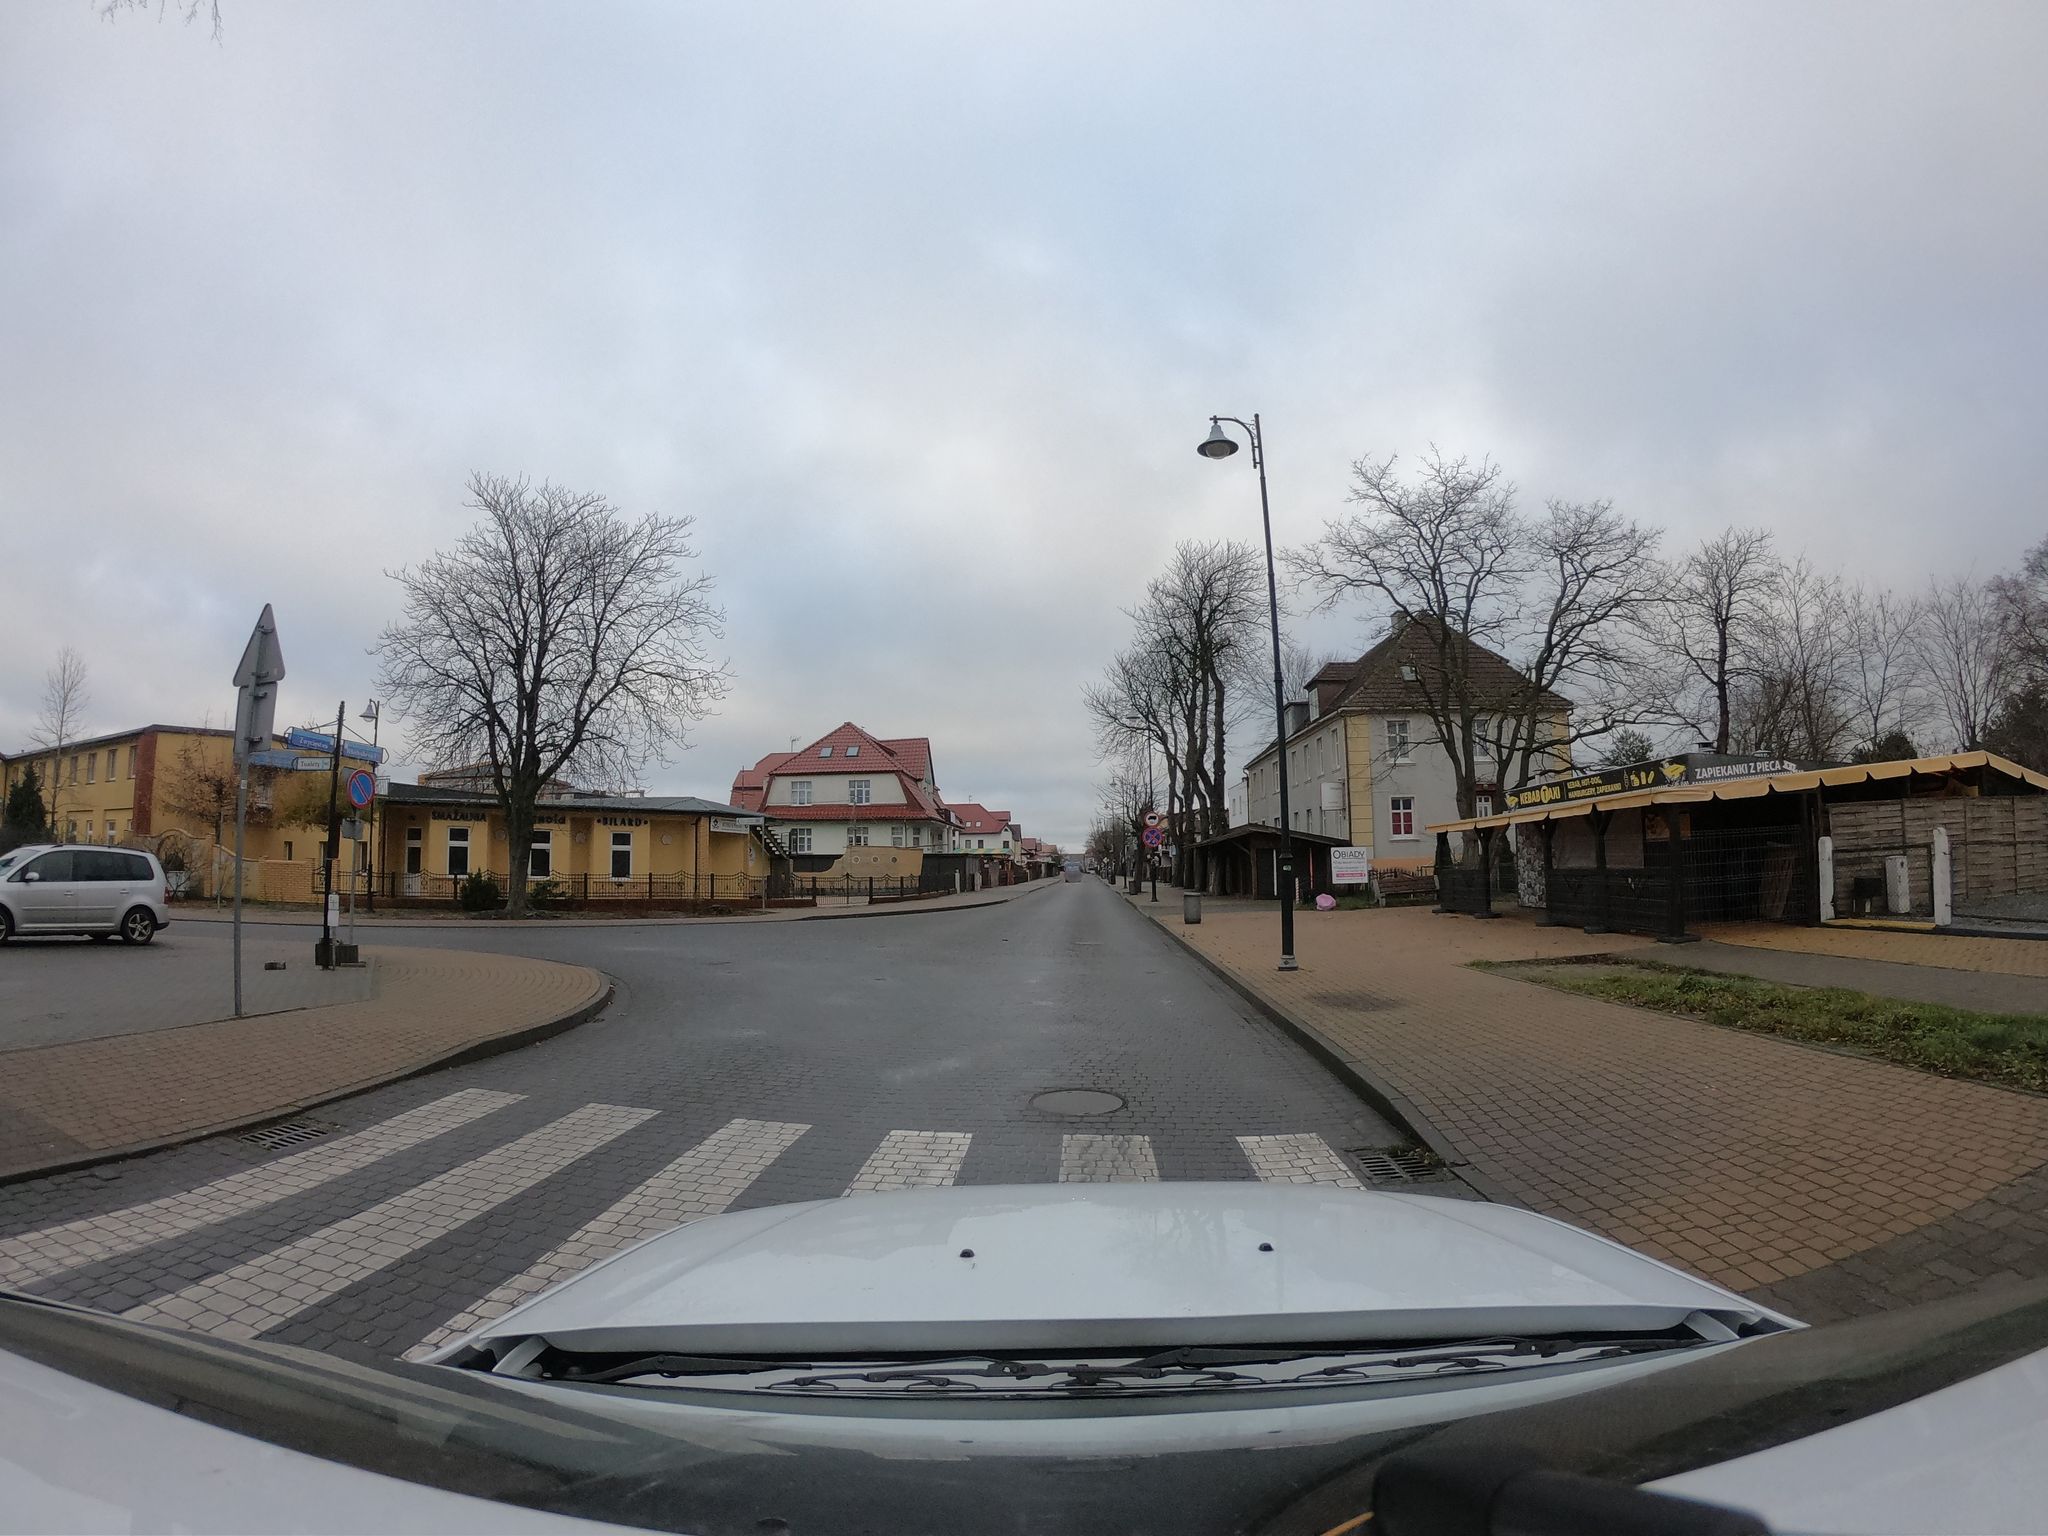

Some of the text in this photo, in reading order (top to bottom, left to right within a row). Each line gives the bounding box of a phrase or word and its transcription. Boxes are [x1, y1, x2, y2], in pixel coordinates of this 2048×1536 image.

[1694, 763, 1748, 780] ZAPIEKANKI
[1749, 763, 1756, 773] Z
[1756, 760, 1781, 772] PIECA
[1333, 850, 1366, 859] OBIADY
